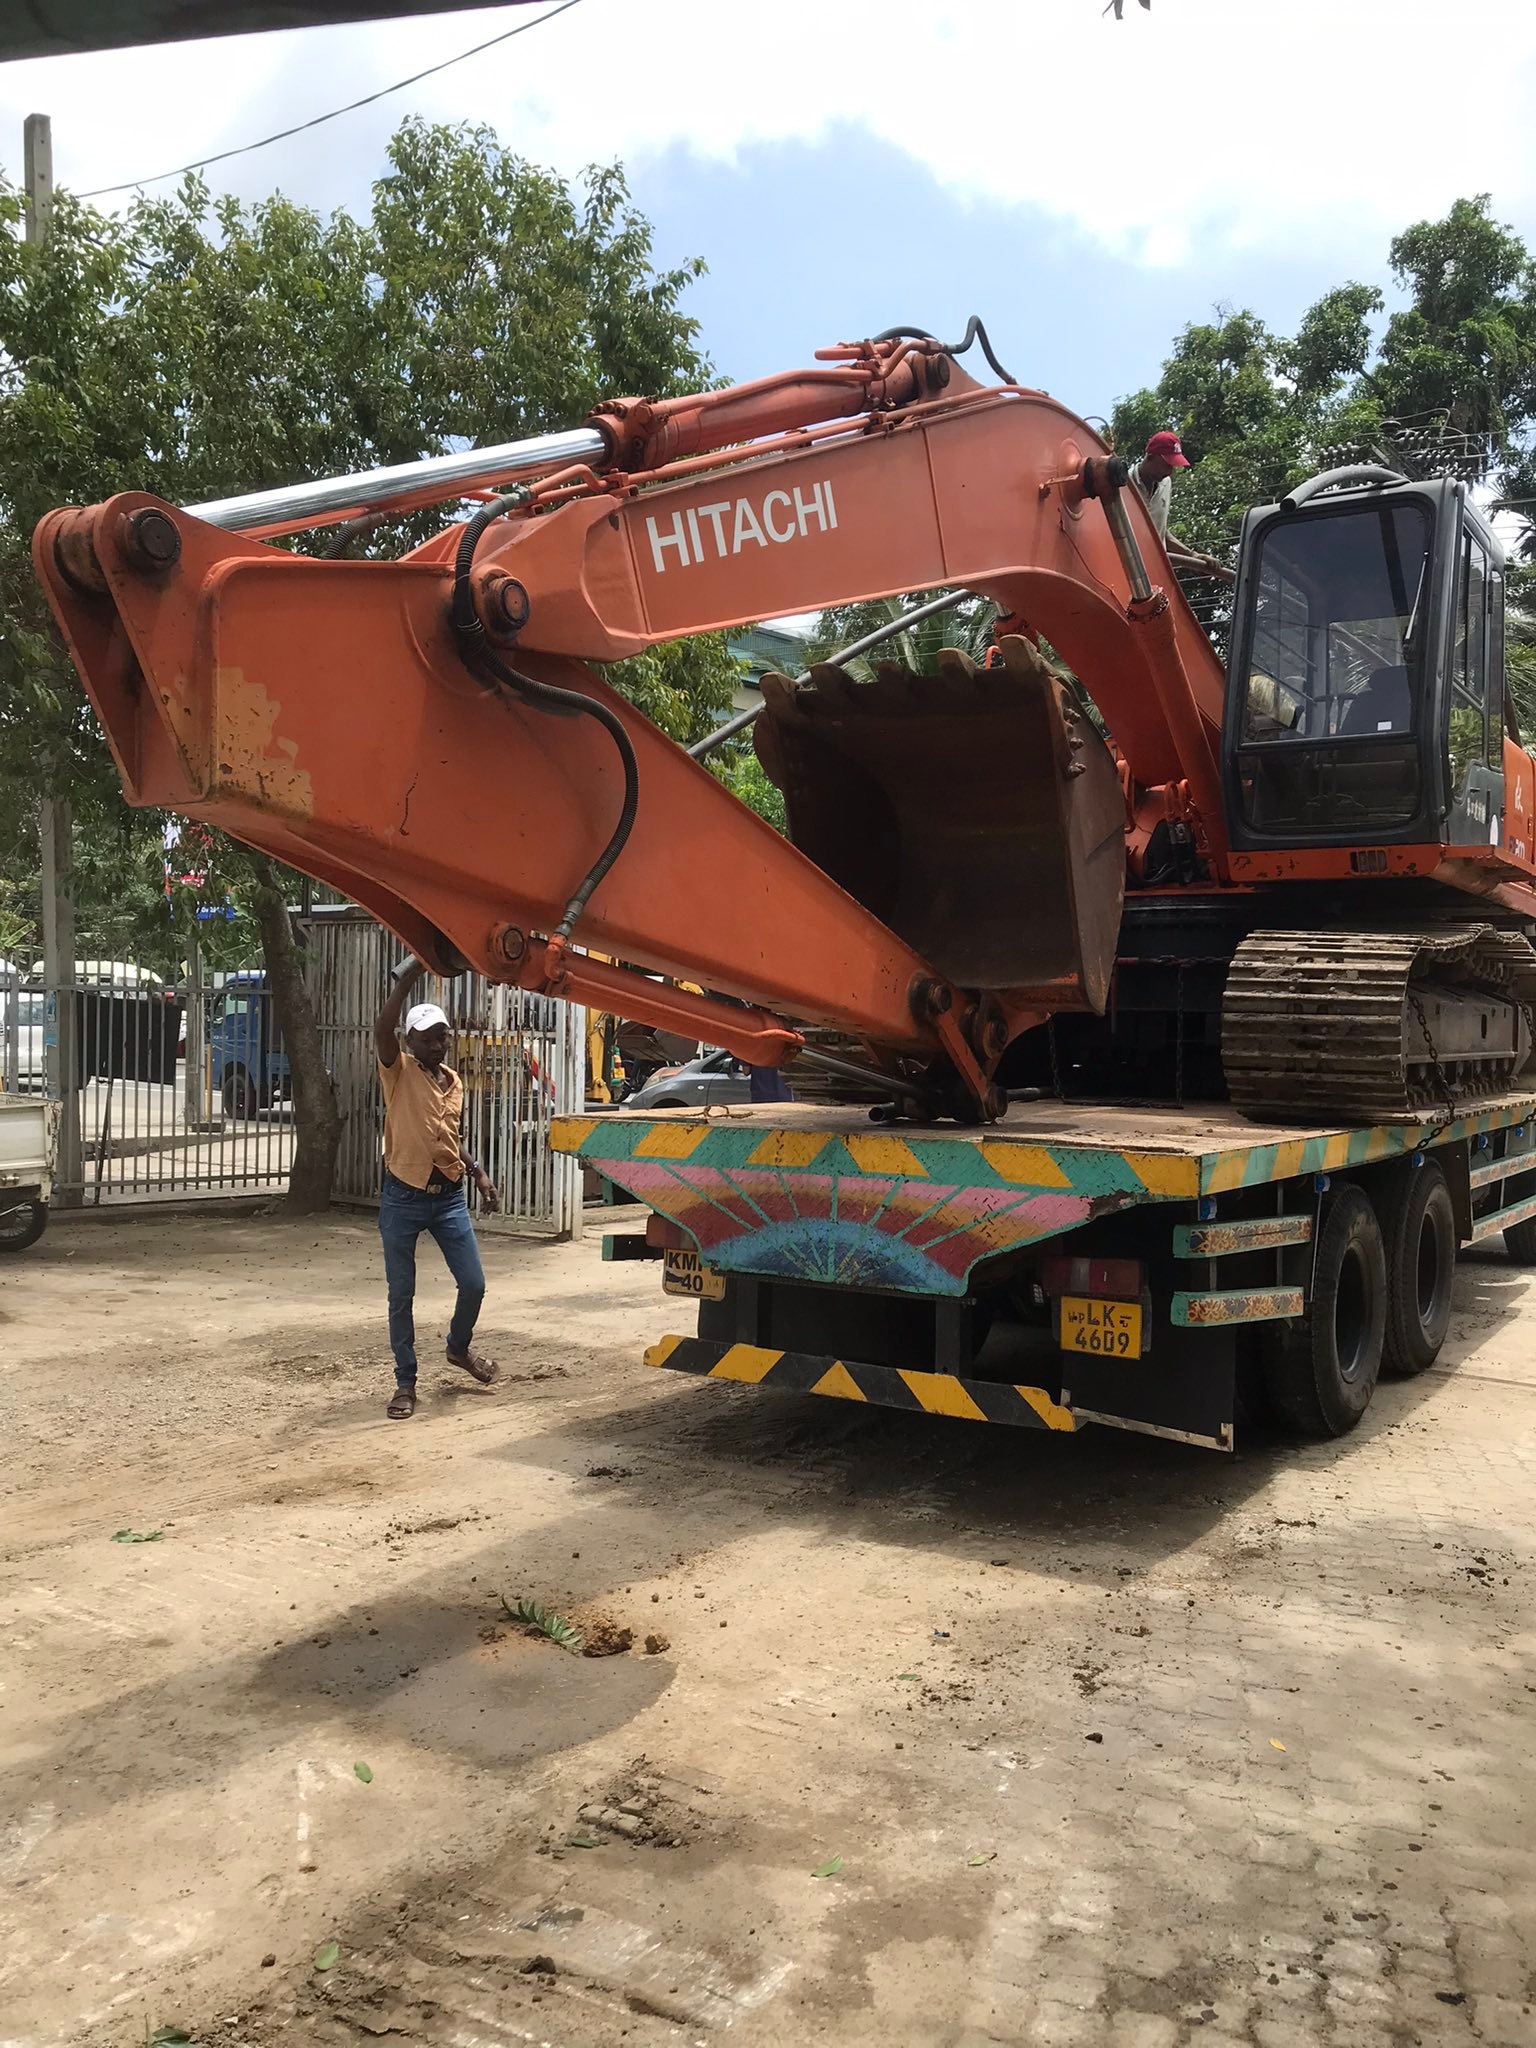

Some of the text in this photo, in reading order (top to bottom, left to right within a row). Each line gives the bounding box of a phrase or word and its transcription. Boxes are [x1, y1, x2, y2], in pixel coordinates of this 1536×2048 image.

[645, 480, 838, 573] HITACHI
[668, 1251, 702, 1271] KM
[1087, 1302, 1115, 1328] LK
[1075, 1327, 1130, 1354] 4609
